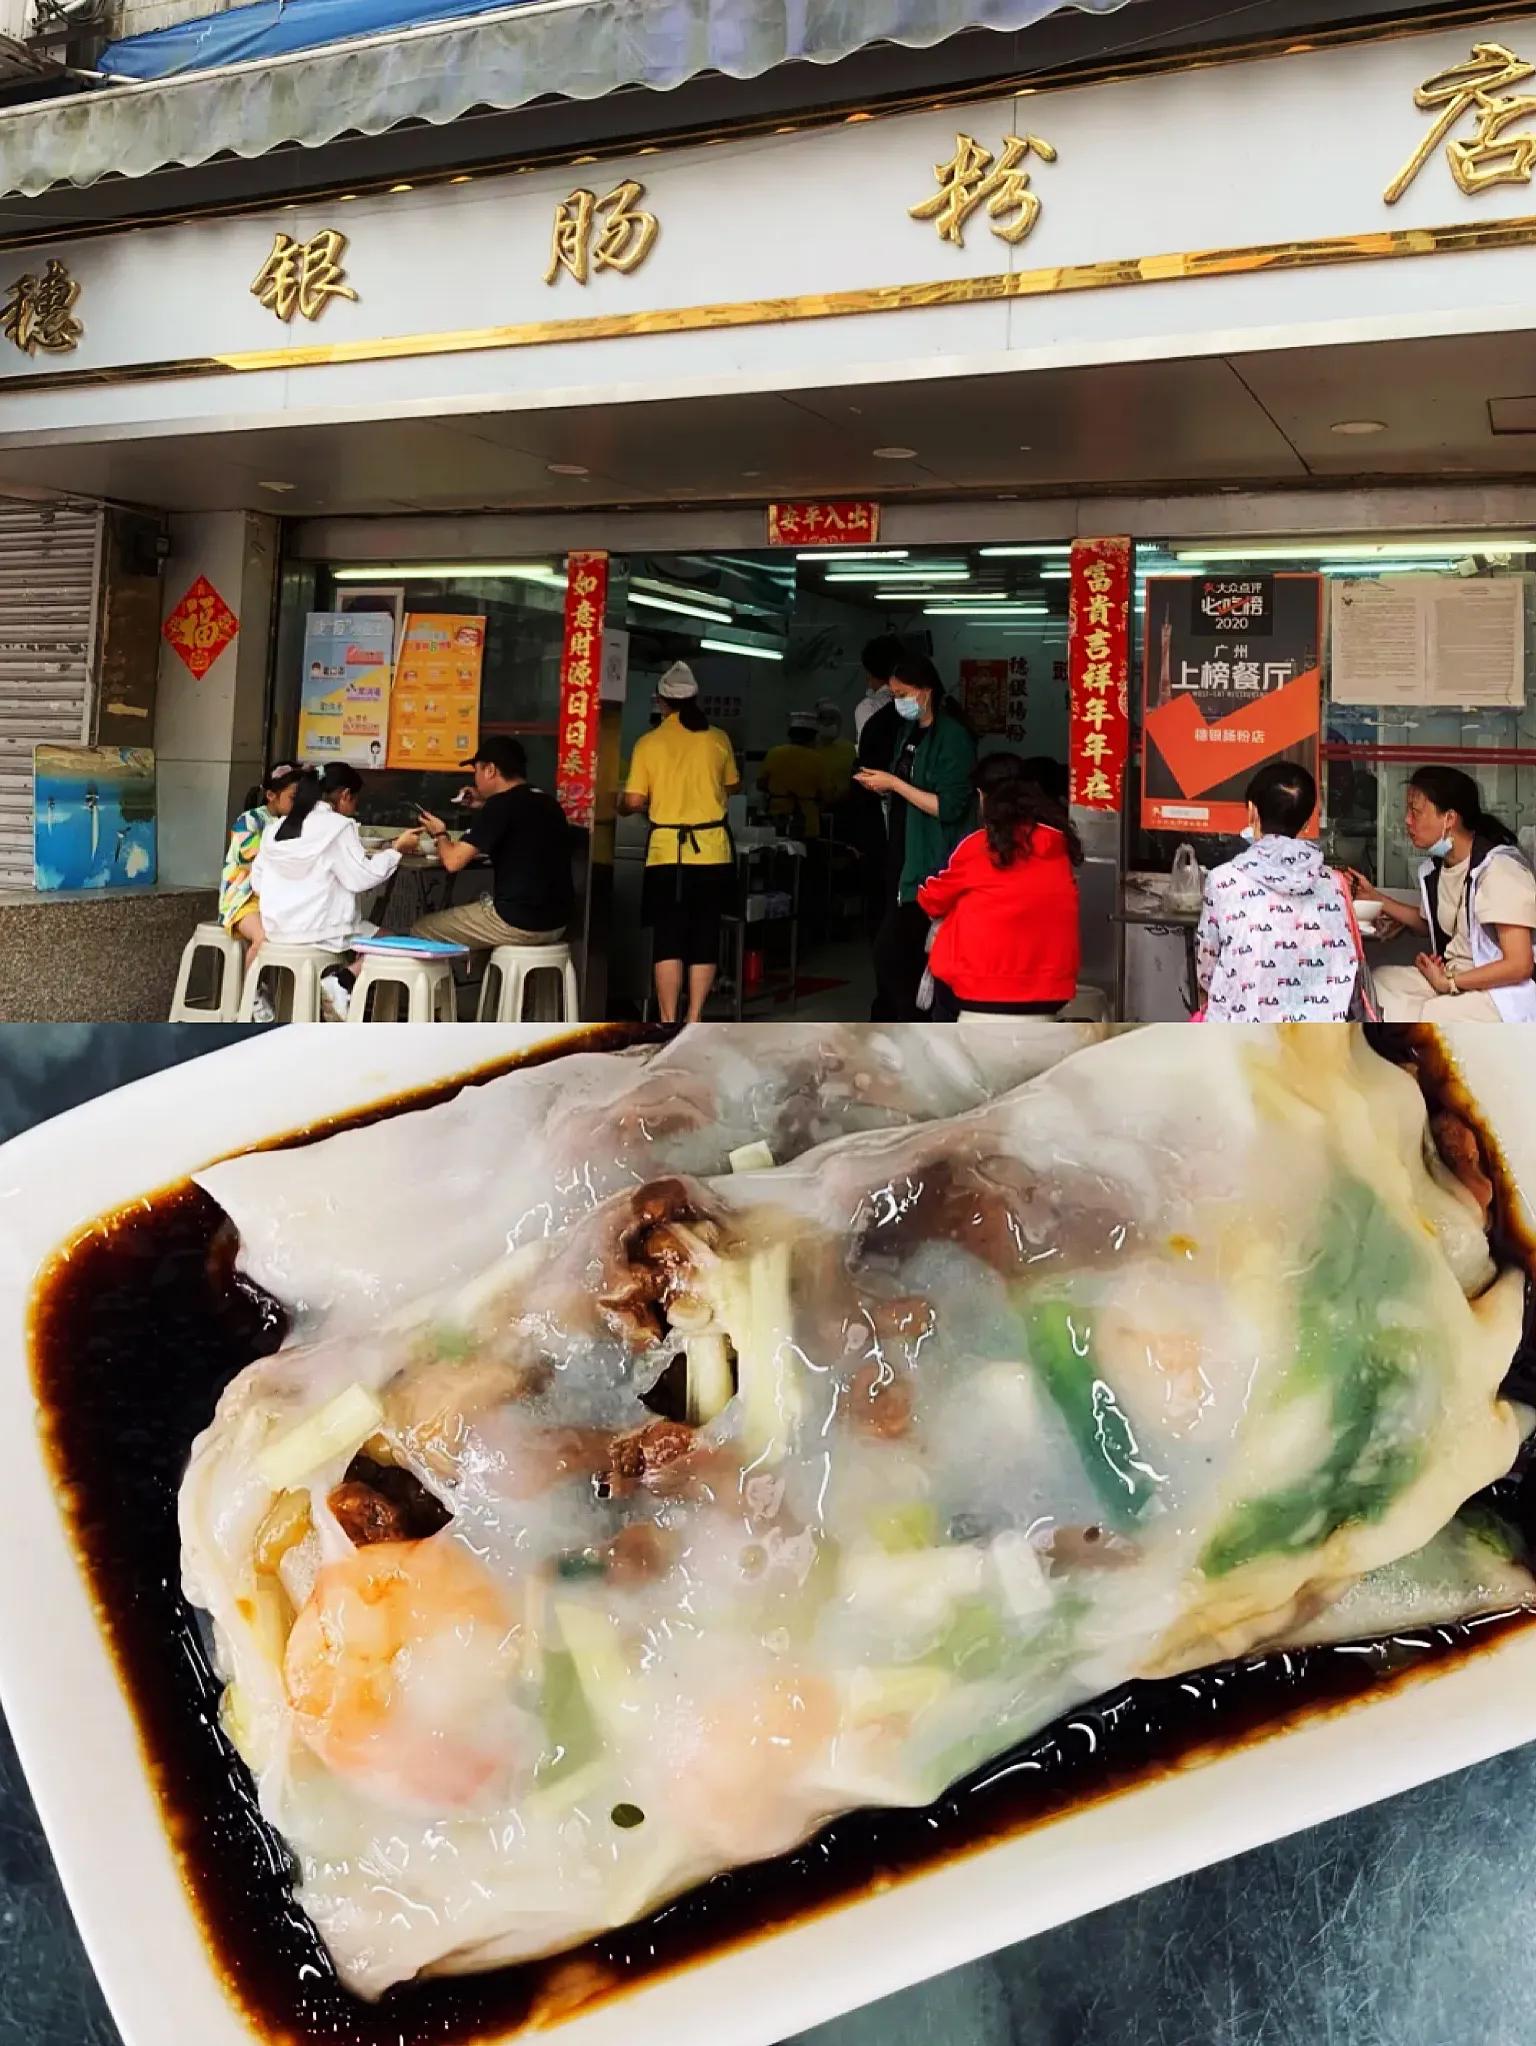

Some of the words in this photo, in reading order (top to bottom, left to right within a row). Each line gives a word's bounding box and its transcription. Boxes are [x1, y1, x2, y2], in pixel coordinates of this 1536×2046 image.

[1216, 582, 1262, 594] 大众点评
[179, 596, 220, 649] 福
[1216, 617, 1249, 630] 2020
[1214, 644, 1248, 659] 广州
[1171, 660, 1293, 690] 上榜餐厅
[1317, 904, 1341, 912] FILA
[1296, 922, 1321, 930] FILA
[1274, 941, 1298, 950] FILA
[1322, 939, 1347, 949] FILA
[1299, 958, 1325, 968] FILA
[1277, 978, 1301, 987] FILA
[1326, 975, 1351, 985] FILA
[1258, 997, 1280, 1006] FILA
[1304, 995, 1330, 1004] FILA
